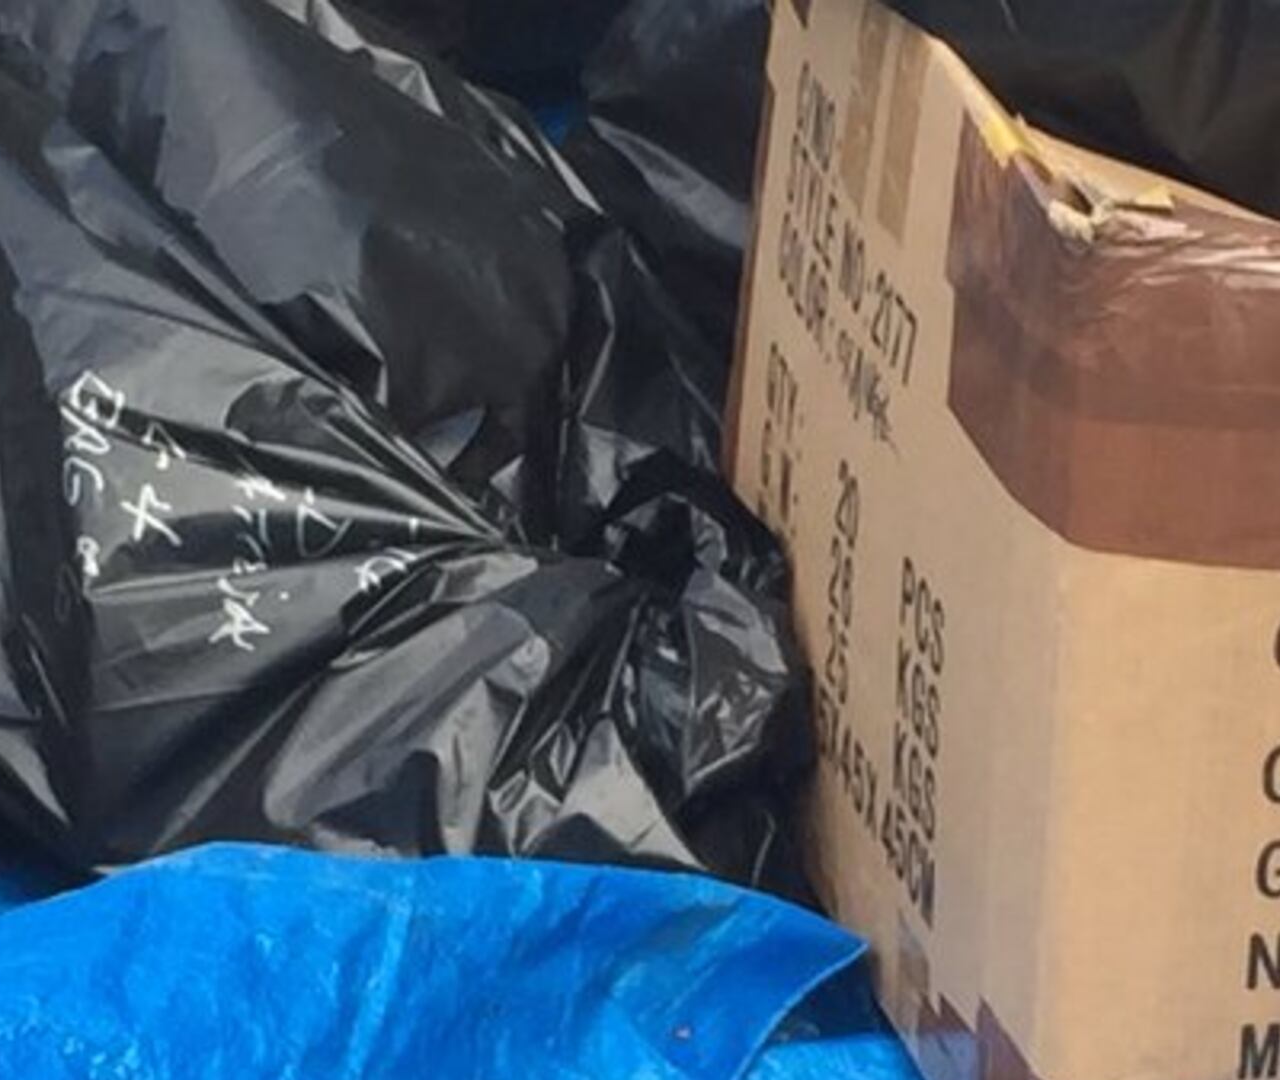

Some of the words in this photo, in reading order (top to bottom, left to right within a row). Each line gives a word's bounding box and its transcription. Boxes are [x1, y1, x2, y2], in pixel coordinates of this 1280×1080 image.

[900, 556, 945, 675] PCS
[897, 633, 940, 760] KGS
[892, 720, 936, 842] KGS
